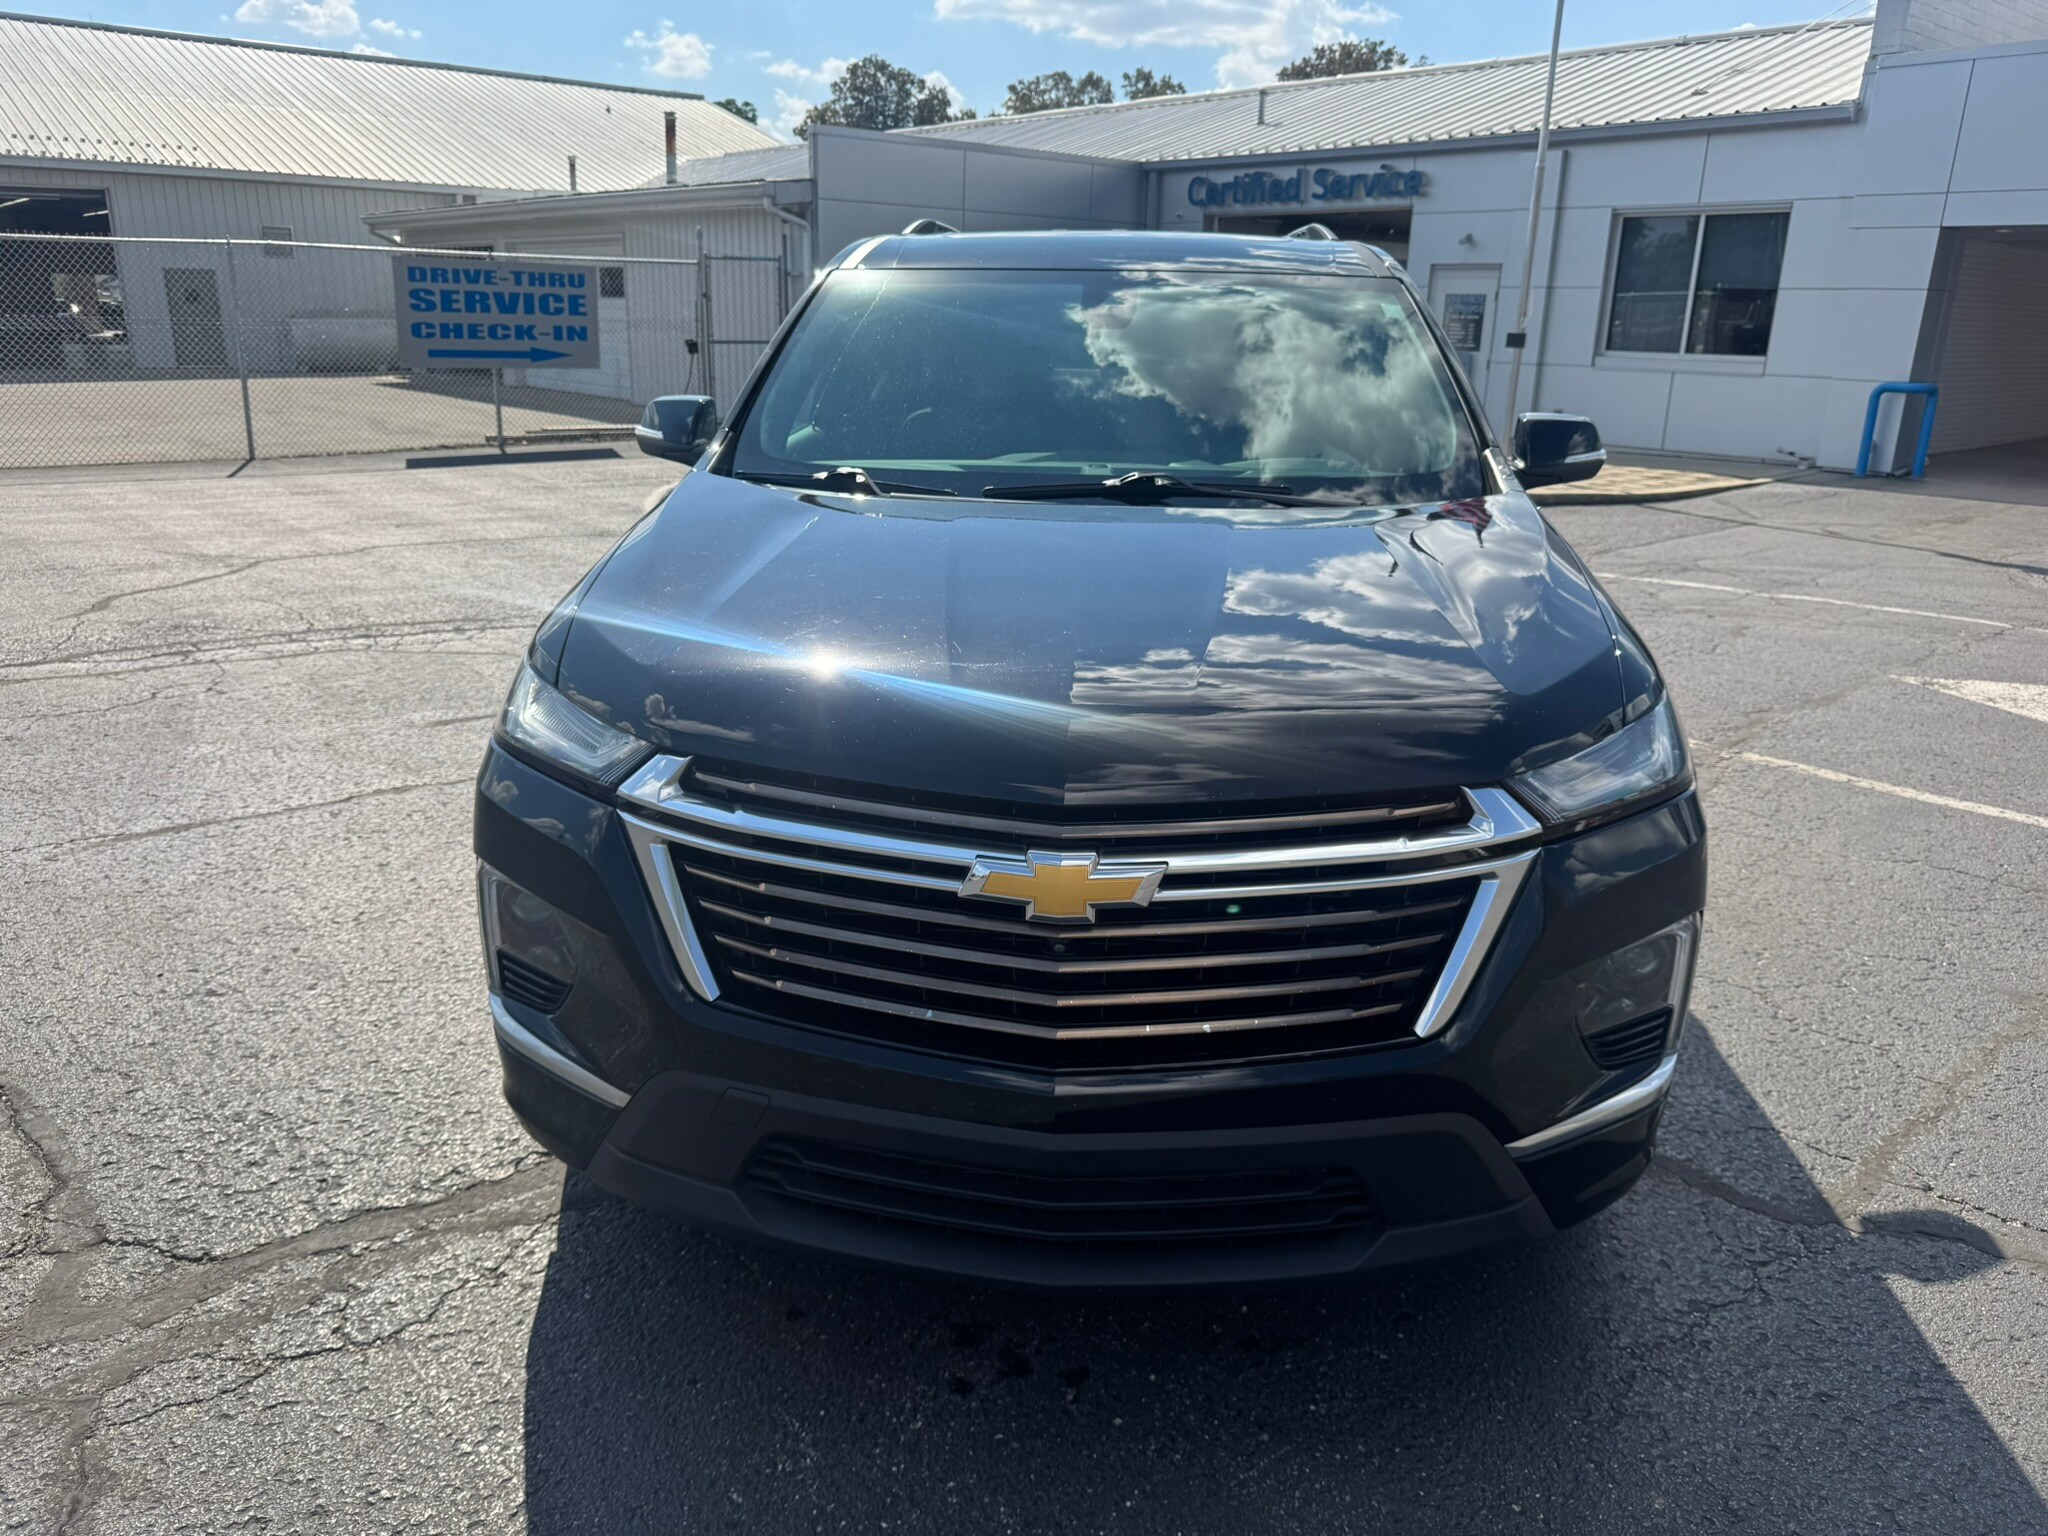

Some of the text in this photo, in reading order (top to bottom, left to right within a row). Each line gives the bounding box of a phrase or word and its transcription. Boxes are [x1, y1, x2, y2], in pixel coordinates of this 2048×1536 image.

[1188, 164, 1427, 206] Certified Service
[407, 266, 585, 288] DRIVE-THRU
[408, 288, 588, 316] SERVICE
[411, 322, 588, 341] CHECK-IN
